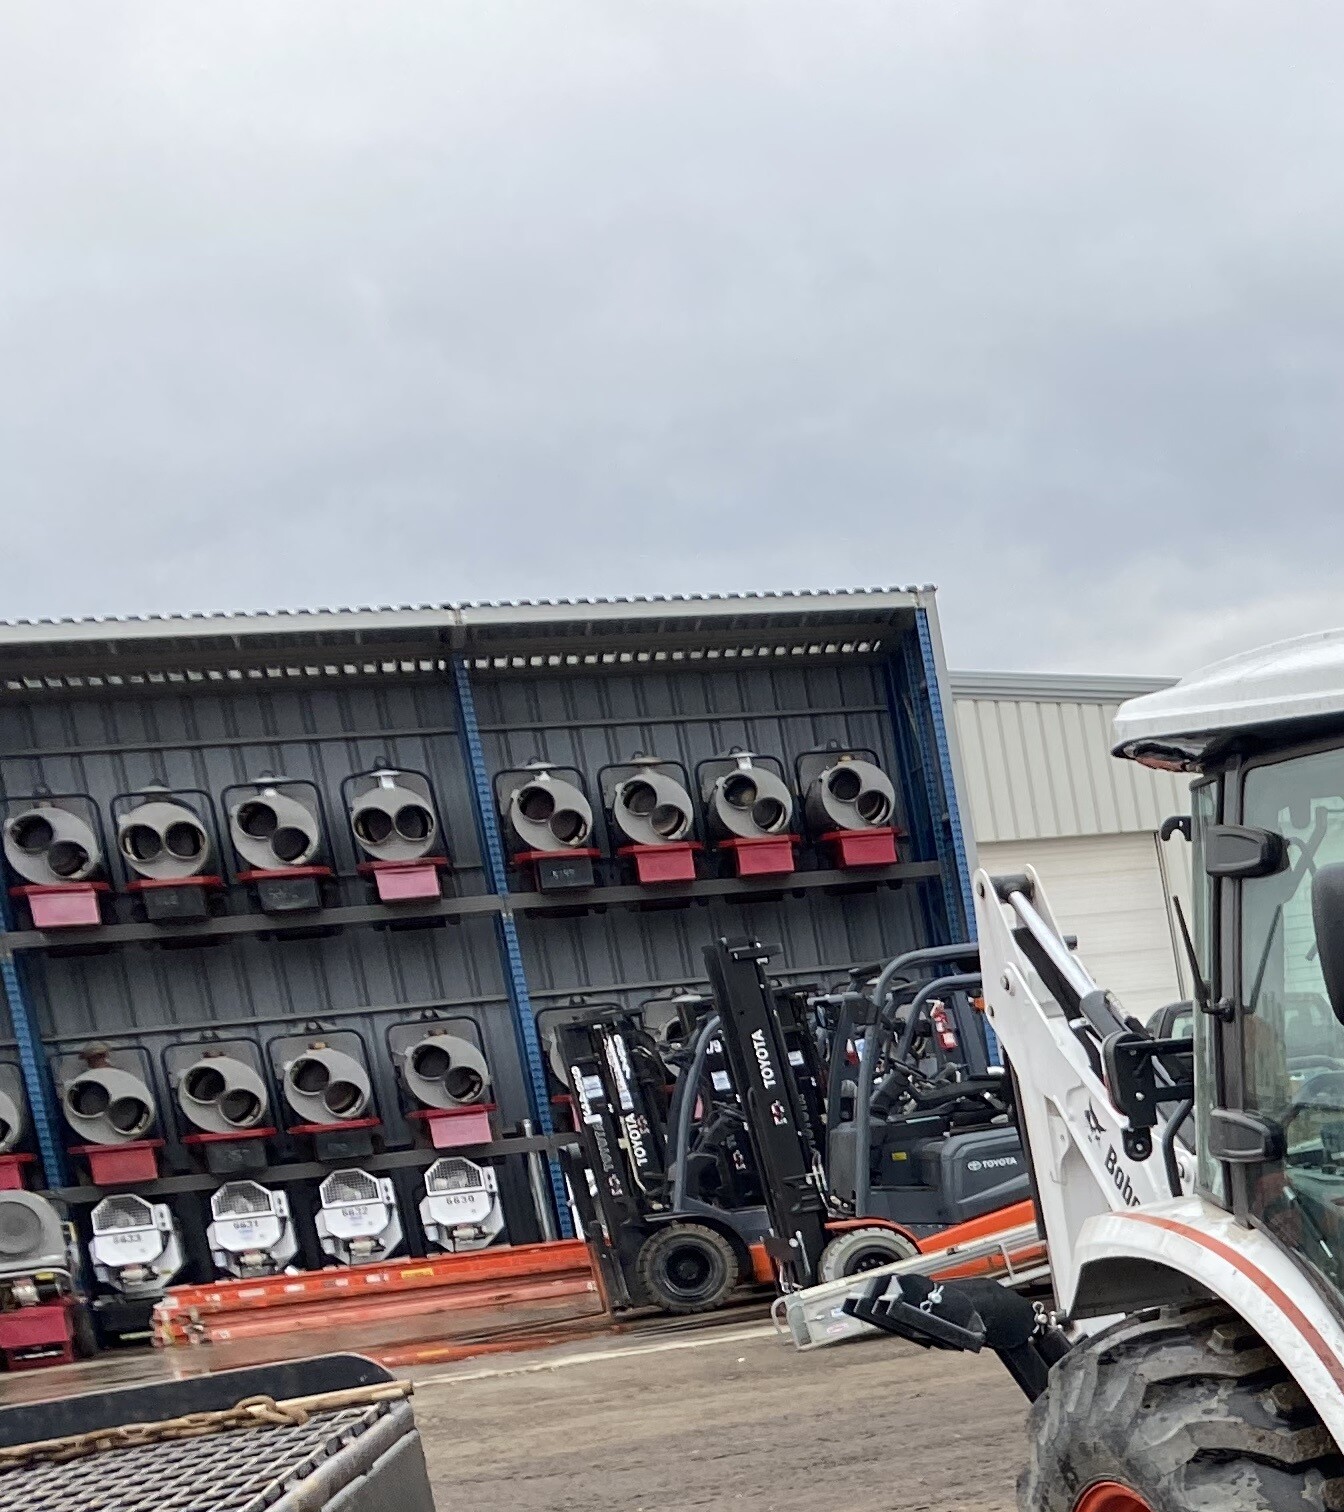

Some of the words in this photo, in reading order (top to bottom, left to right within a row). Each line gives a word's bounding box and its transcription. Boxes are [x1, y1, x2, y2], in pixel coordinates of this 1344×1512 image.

[751, 1029, 777, 1090] TOYOTA
[625, 1113, 649, 1167] TOYOTA
[983, 1156, 1018, 1169] TOYOTA
